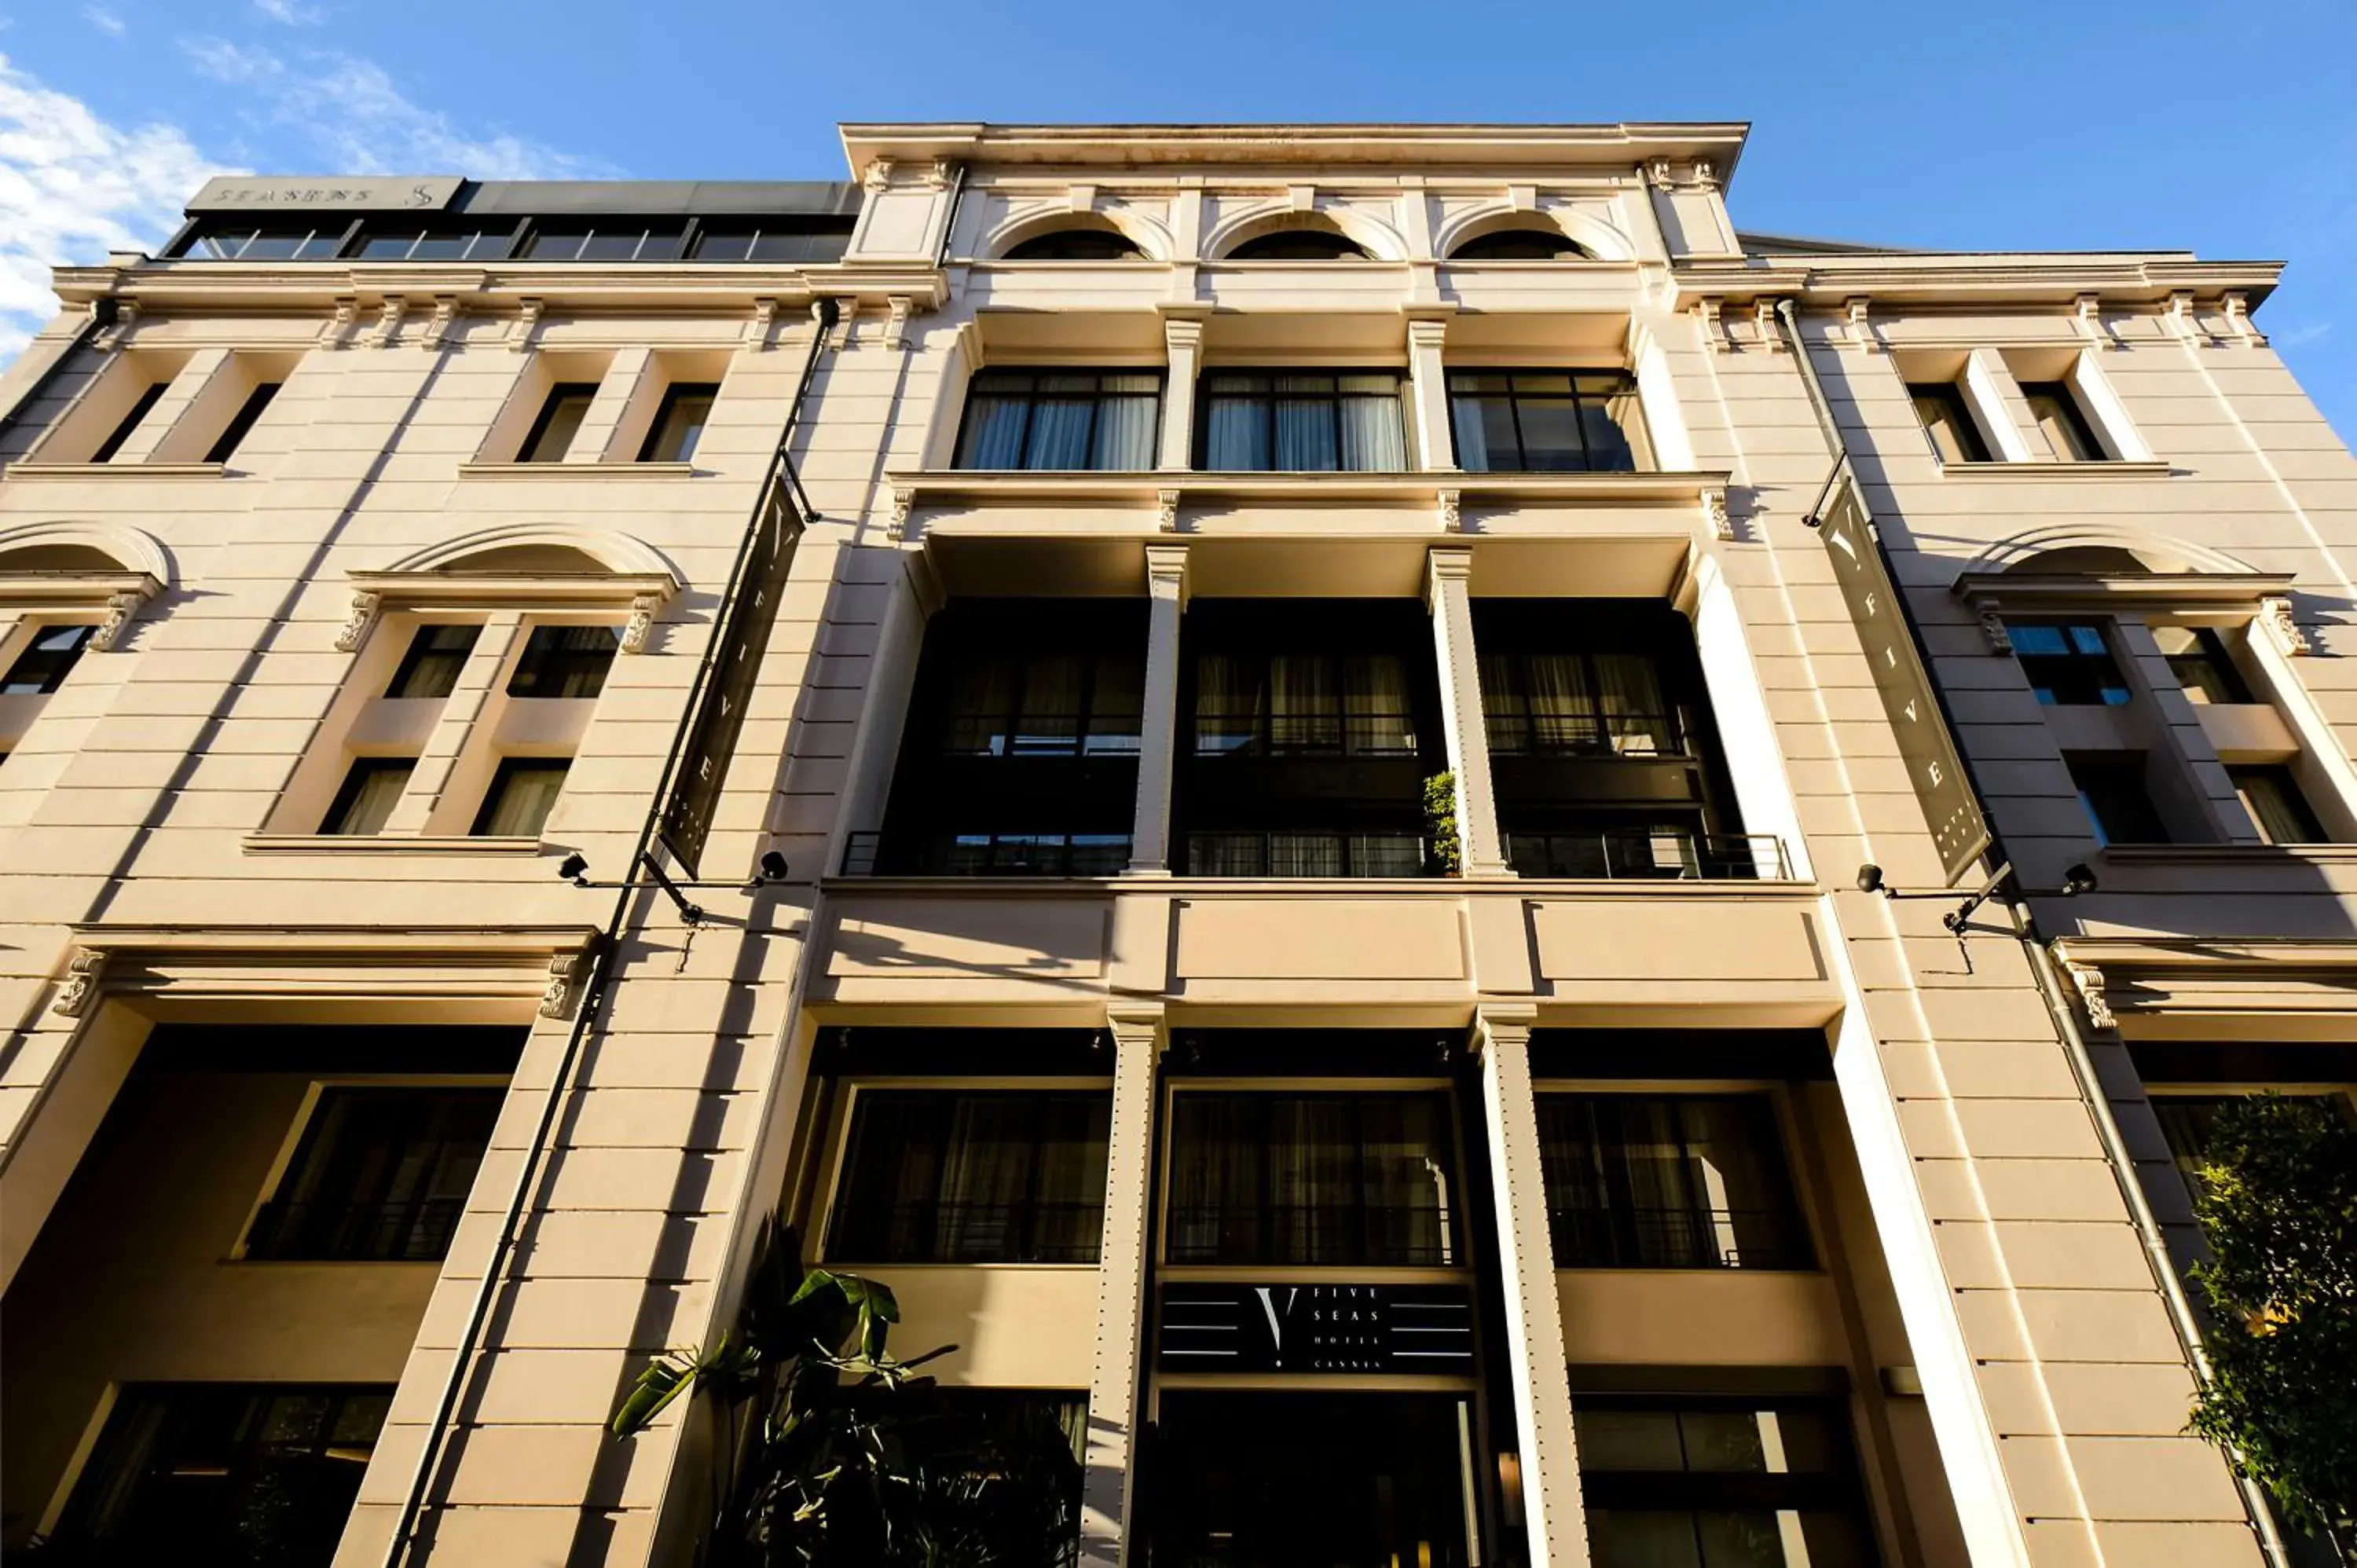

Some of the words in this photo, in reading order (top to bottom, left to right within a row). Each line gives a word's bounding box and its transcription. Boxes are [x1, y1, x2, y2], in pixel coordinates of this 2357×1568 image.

[700, 589, 765, 781] FIVE
[1865, 592, 1943, 788] FIVE
[1314, 1287, 1377, 1299] FIVE
[1314, 1309, 1377, 1321] SEAS
